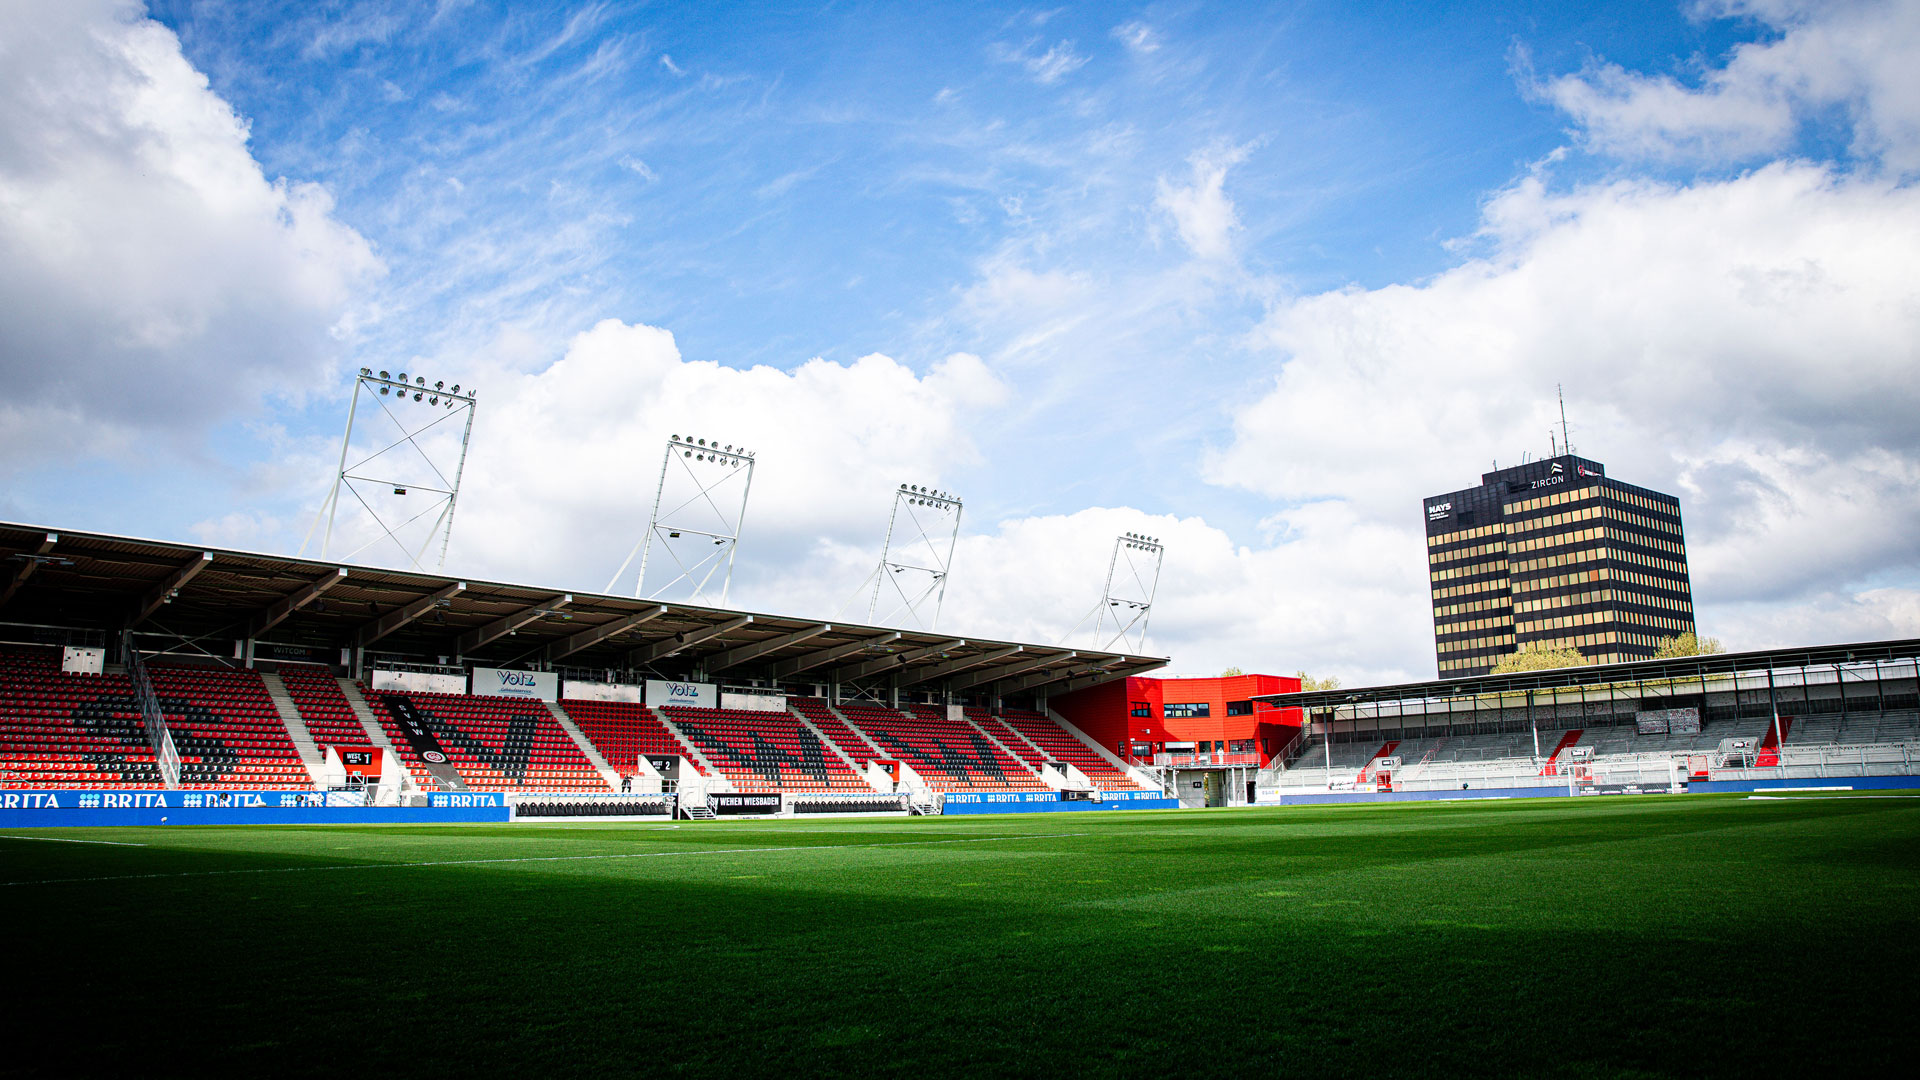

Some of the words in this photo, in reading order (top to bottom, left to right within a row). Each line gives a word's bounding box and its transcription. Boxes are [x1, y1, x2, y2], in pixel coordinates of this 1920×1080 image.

[1531, 475, 1564, 489] ZIRCON
[1429, 503, 1452, 513] HAYS
[273, 646, 306, 655] WITCOM
[364, 753, 370, 764] 1
[665, 760, 671, 771] 2
[0, 794, 59, 808] RITA
[103, 793, 168, 807] BRITA
[450, 794, 497, 807] BRITA
[720, 797, 742, 806] WEHEN
[743, 797, 779, 806] WIESBADEN
[955, 794, 982, 803] BRITA
[996, 794, 1021, 802] BRITA
[1034, 793, 1057, 802] BRITA
